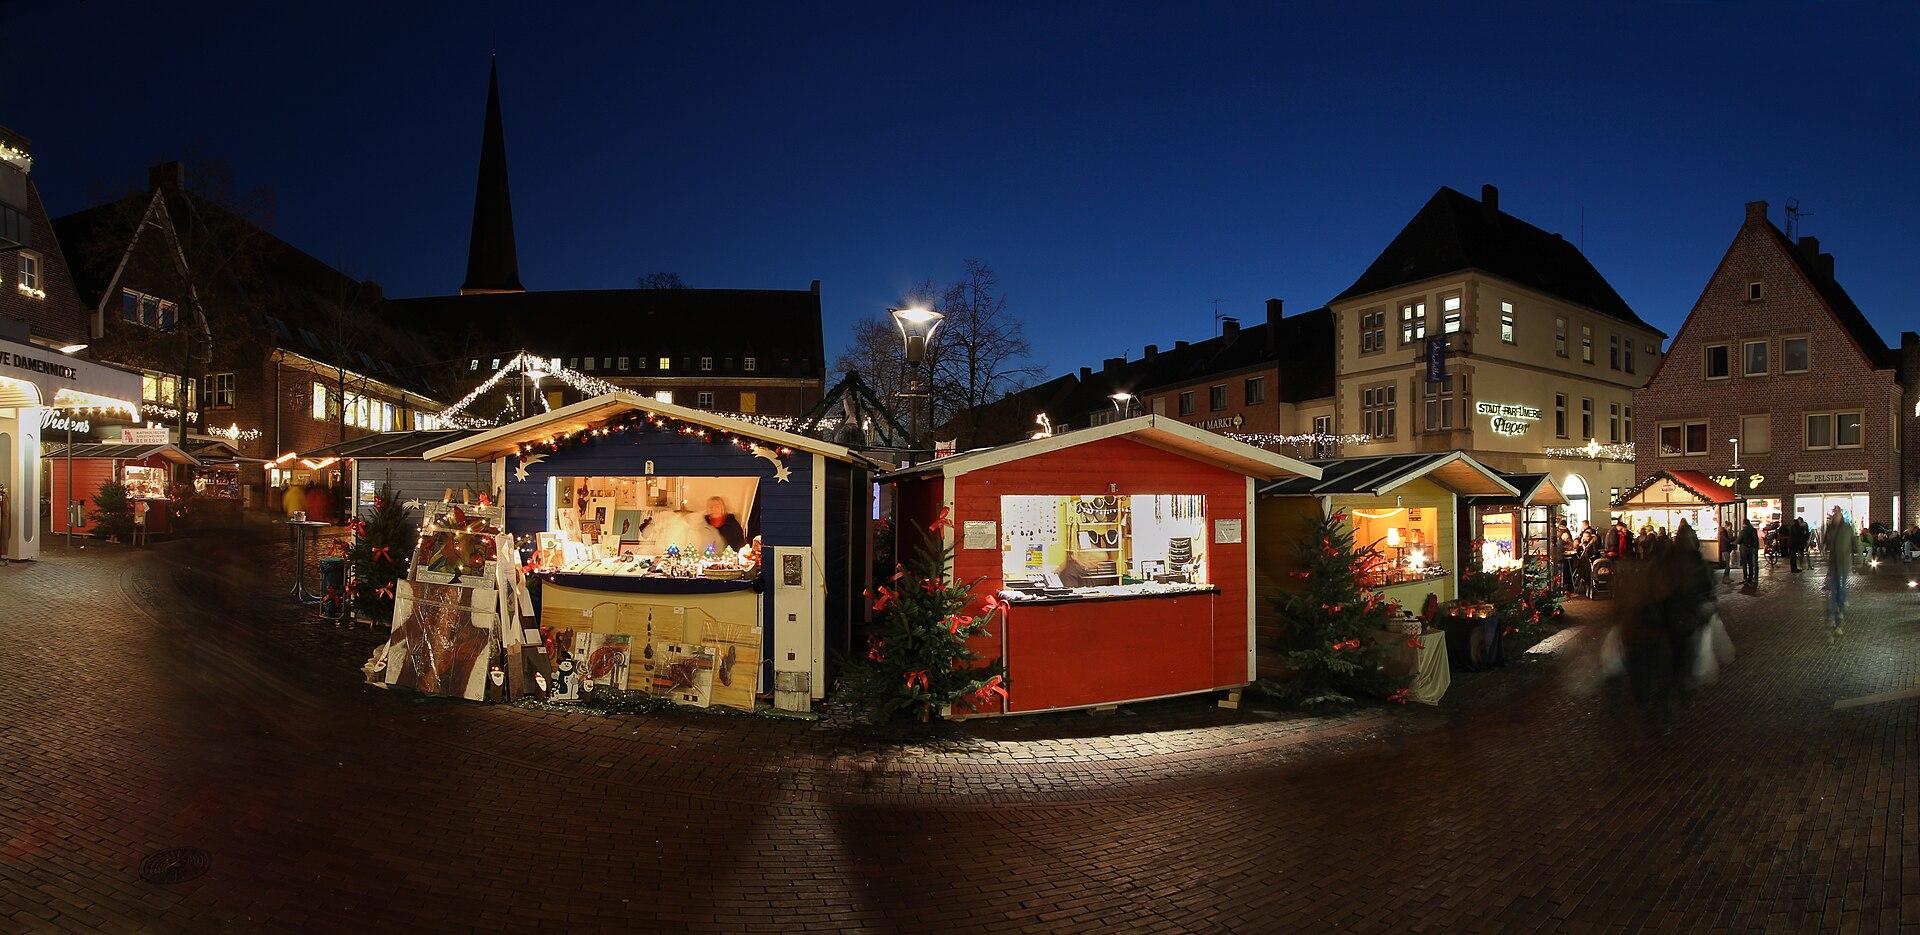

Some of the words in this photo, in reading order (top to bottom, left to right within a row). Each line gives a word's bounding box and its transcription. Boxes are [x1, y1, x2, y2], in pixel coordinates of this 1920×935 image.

[13, 354, 77, 380] DAMENMODE
[1207, 417, 1233, 429] MARKT
[1814, 474, 1843, 482] PELSTER
